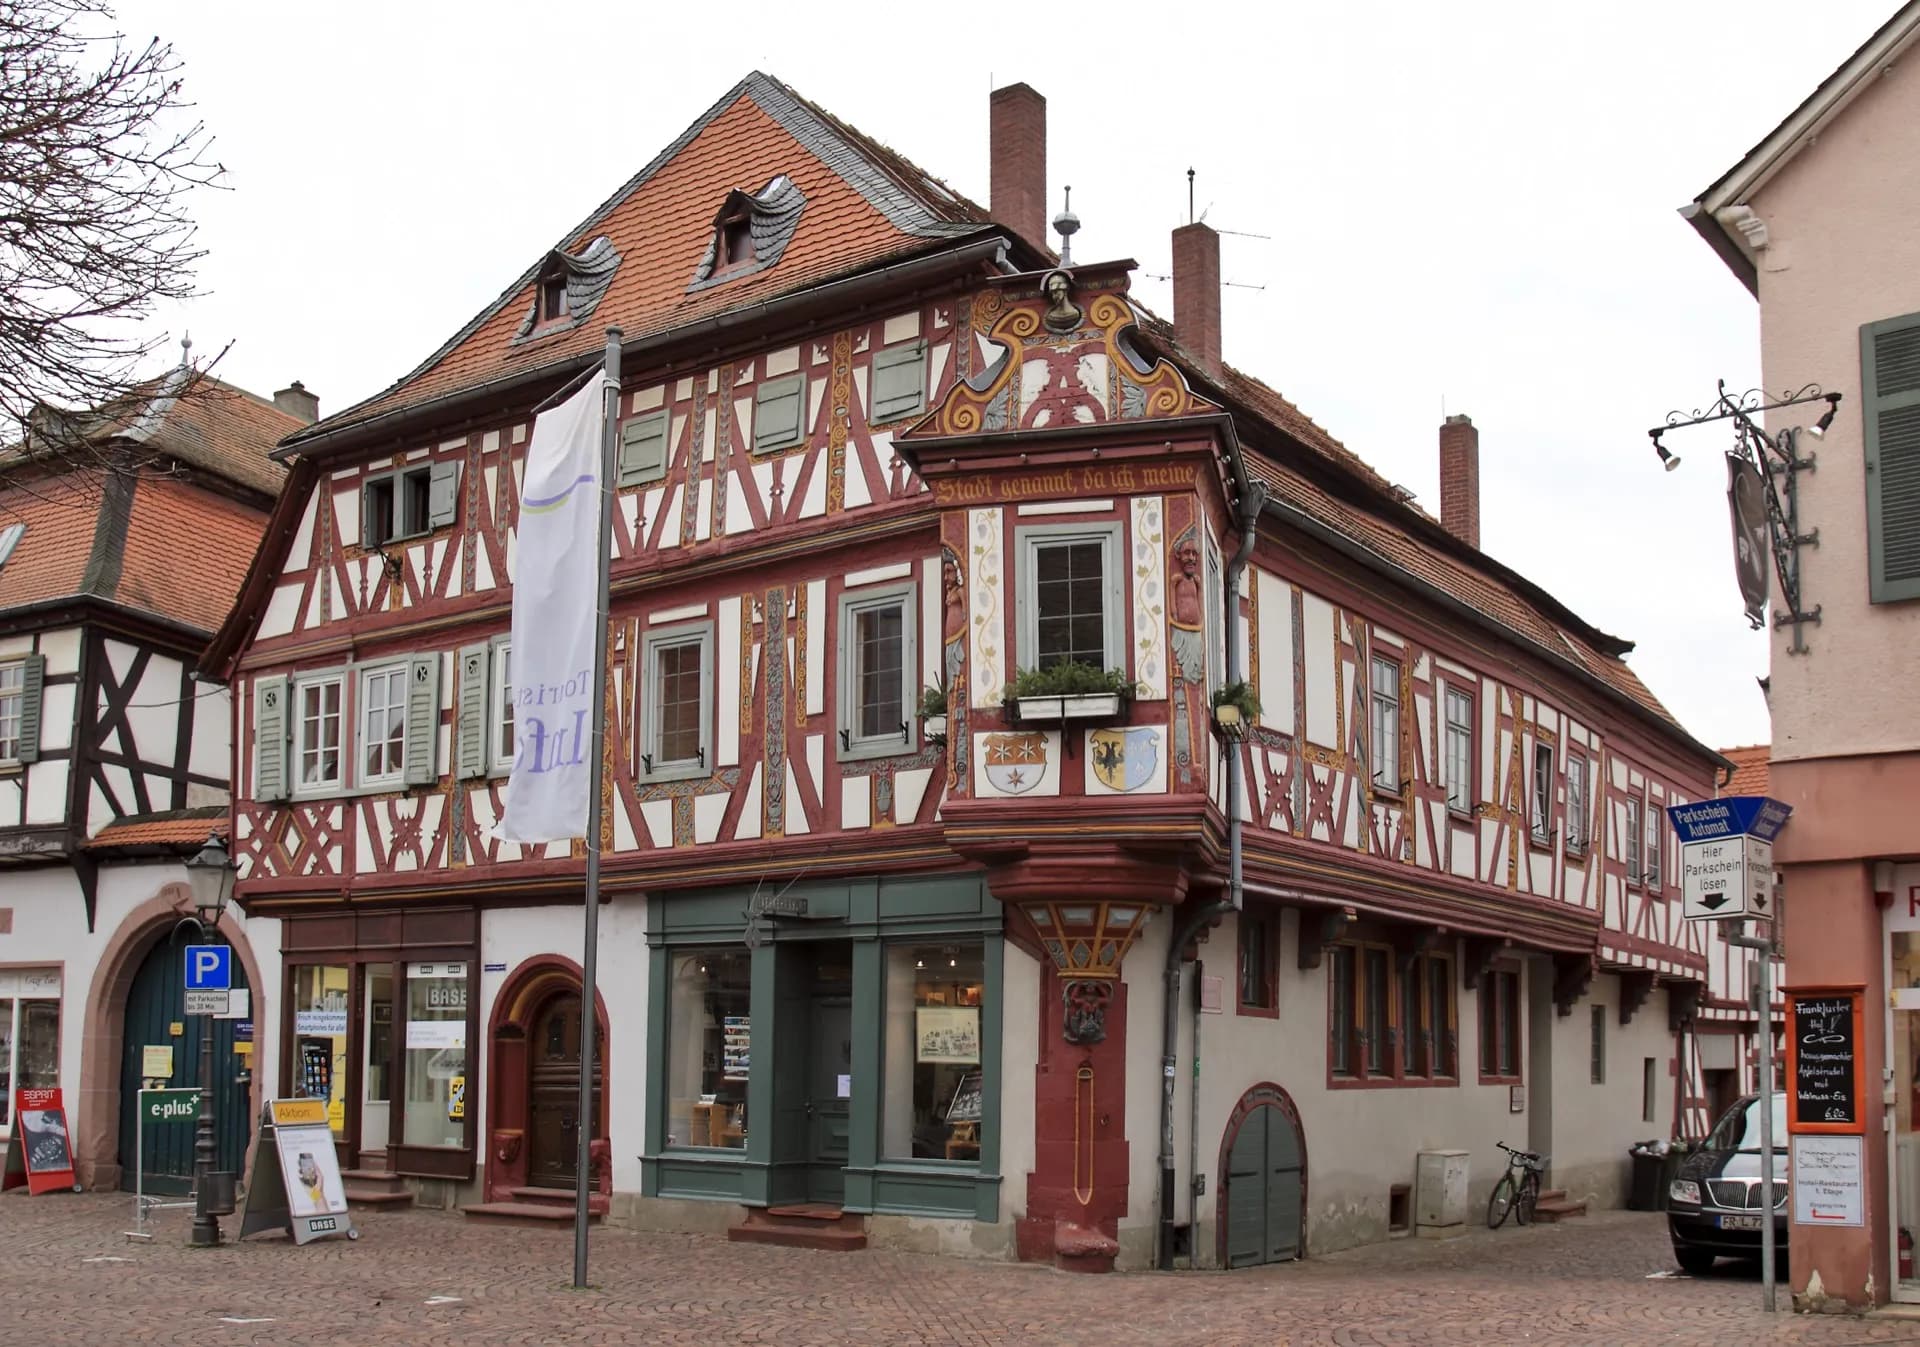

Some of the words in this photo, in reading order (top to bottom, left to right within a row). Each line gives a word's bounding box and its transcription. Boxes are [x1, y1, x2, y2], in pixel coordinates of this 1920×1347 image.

[935, 474, 993, 503] Stadt
[997, 470, 1078, 501] genannt,
[1082, 466, 1106, 488] da
[1109, 463, 1140, 492] ich
[1142, 463, 1194, 486] meine
[1674, 803, 1730, 824] Parkschein
[1688, 819, 1731, 838] Automat
[1702, 846, 1723, 858] Hier
[1685, 860, 1741, 877] Parkschein
[1699, 879, 1727, 891] lösen
[195, 951, 220, 984] P
[430, 988, 466, 1005] BASE
[1795, 1000, 1851, 1018] Frankfurter
[23, 1089, 55, 1100] ESPRIT
[311, 1220, 335, 1230] BASE
